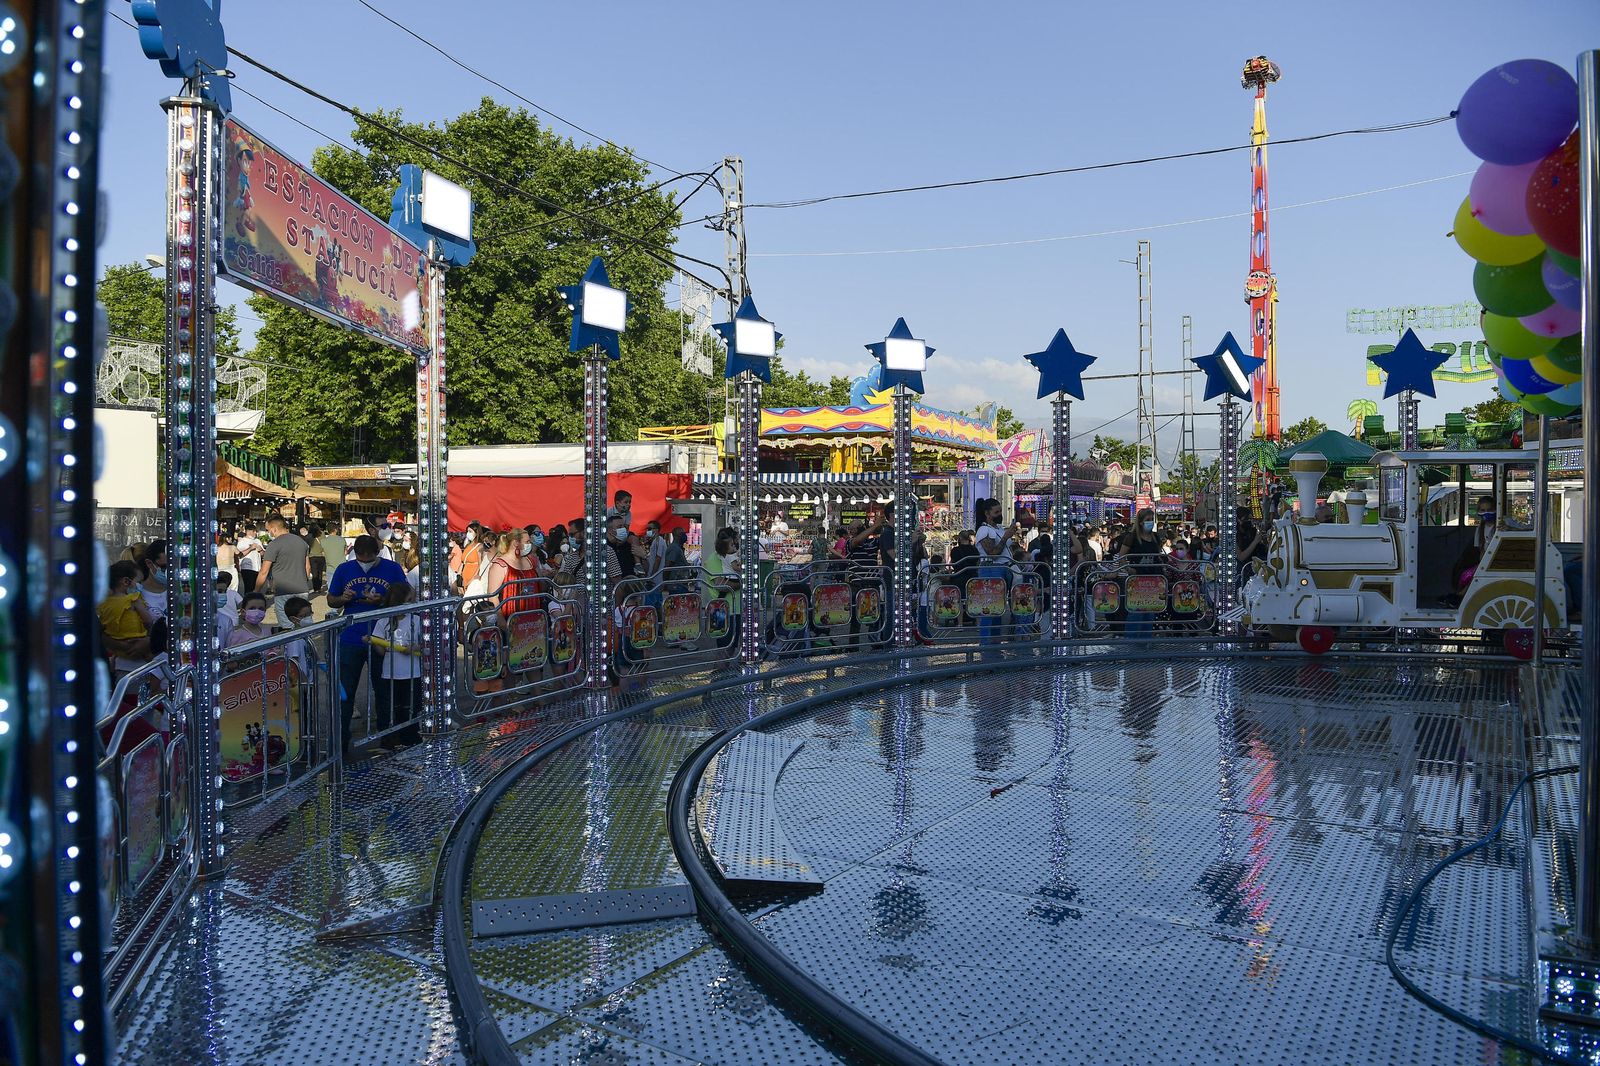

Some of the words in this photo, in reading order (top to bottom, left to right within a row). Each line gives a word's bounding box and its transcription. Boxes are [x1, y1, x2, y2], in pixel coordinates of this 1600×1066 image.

[264, 159, 375, 255] ESTACIÓN
[393, 241, 412, 277] DE
[238, 244, 283, 286] Salida
[343, 250, 398, 302] LUCÍA
[221, 442, 290, 489] FORTUNA
[146, 516, 162, 527] DE
[345, 577, 367, 590] UNITED
[223, 675, 288, 711] SALIDA
